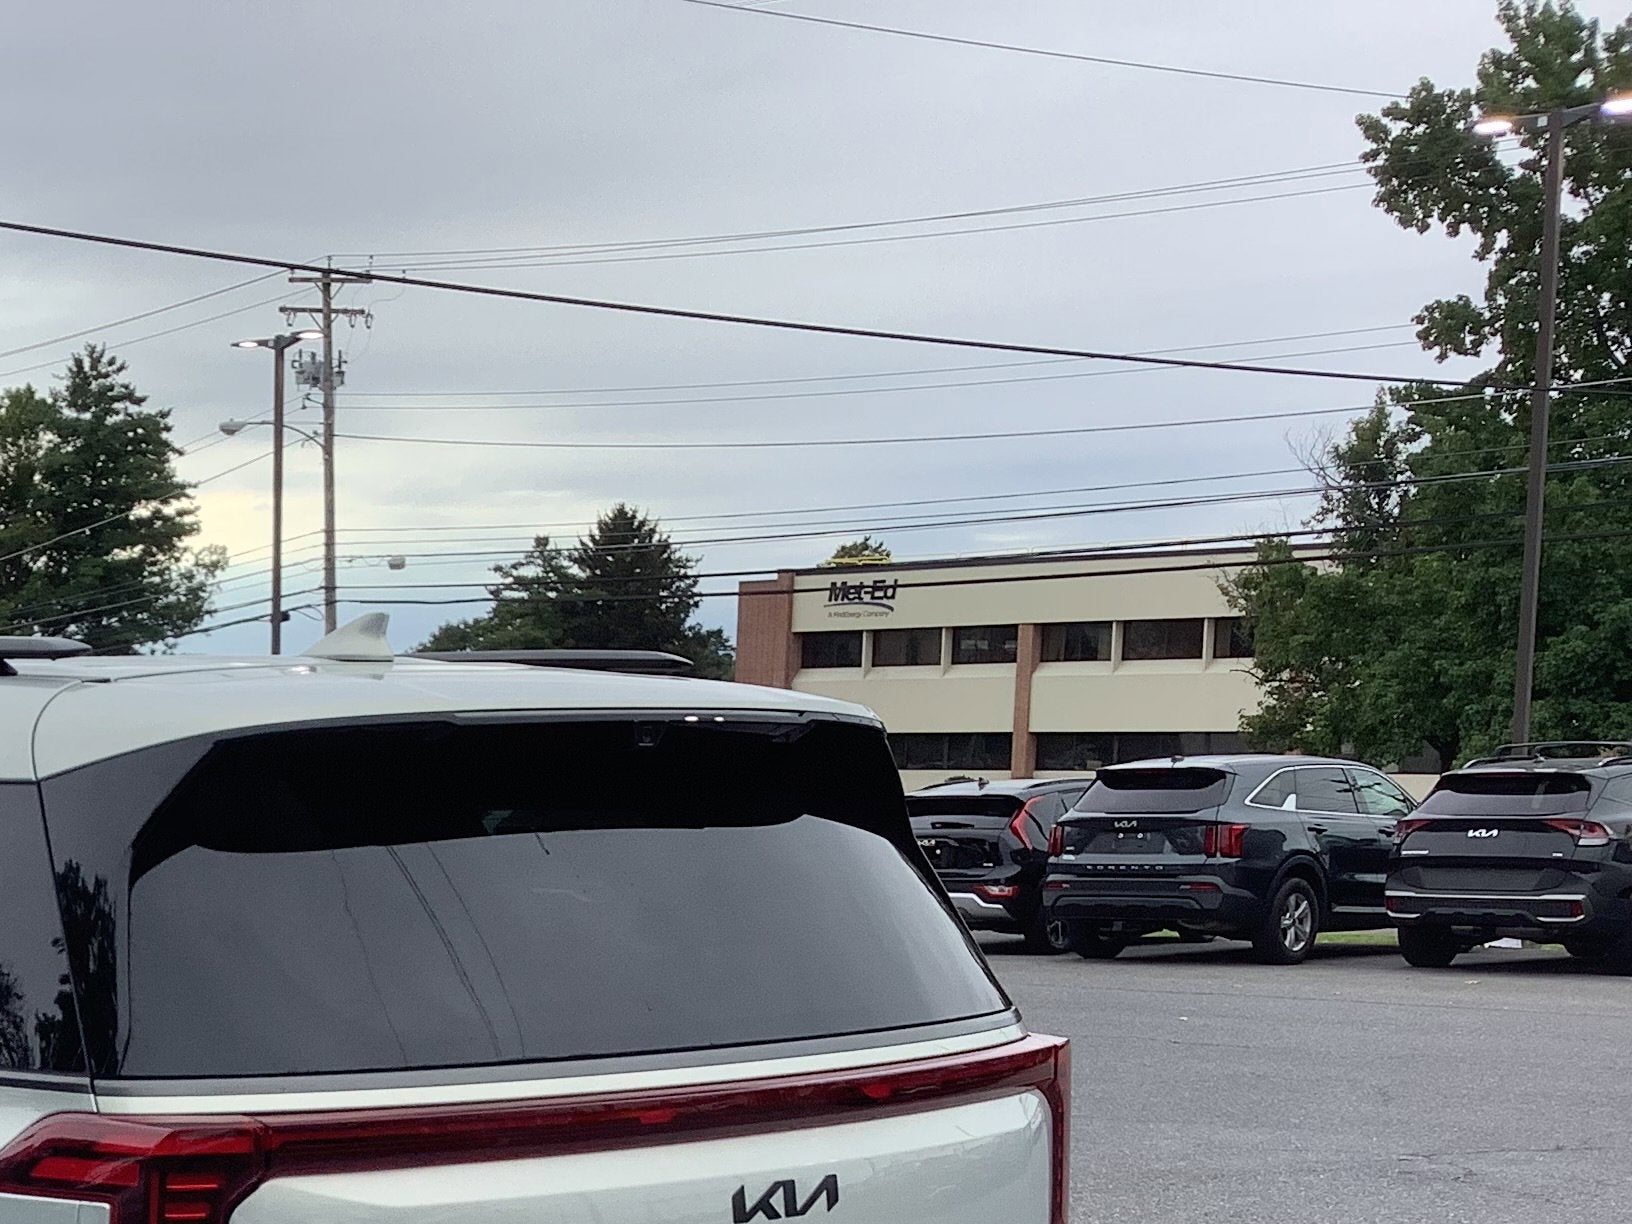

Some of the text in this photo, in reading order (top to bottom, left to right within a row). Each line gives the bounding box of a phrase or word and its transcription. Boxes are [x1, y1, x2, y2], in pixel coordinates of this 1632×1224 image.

[828, 579, 898, 602] Met-Ed
[1114, 820, 1137, 828] KIA
[1467, 828, 1499, 838] KIA
[732, 1174, 839, 1224] KIA
